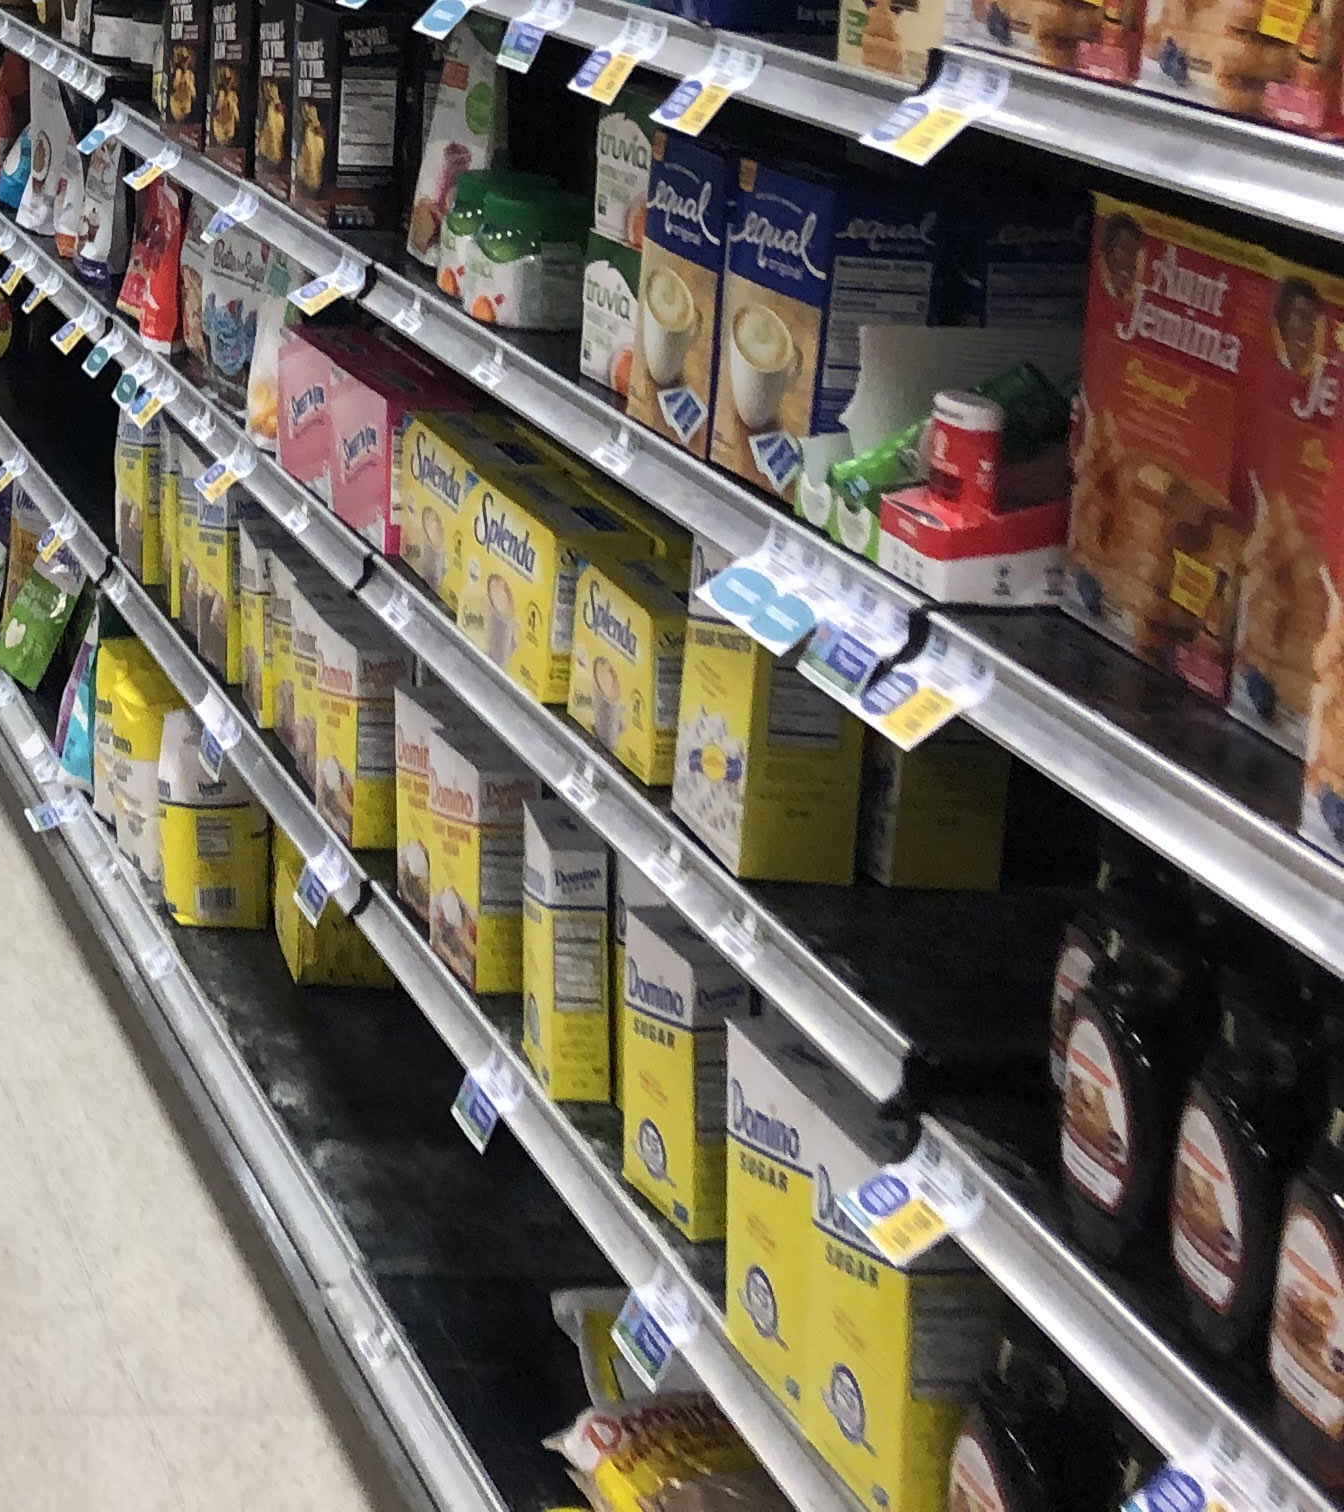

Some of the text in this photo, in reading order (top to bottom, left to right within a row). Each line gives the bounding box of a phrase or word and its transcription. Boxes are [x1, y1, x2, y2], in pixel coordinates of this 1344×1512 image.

[645, 180, 721, 247] equal
[728, 210, 828, 281] equal
[835, 211, 937, 252] equal
[1151, 242, 1230, 319] Aunt
[1116, 283, 1244, 374] Jemima
[410, 431, 462, 507] Splenda
[474, 491, 537, 575] Splenda
[583, 580, 638, 657] Splenda
[396, 723, 430, 776] Domin
[627, 955, 684, 1018] Domino
[632, 1016, 676, 1049] SUGAR
[730, 1077, 801, 1161] Domino
[739, 1149, 789, 1194] SUGAR
[824, 1242, 881, 1290] SUGAR
